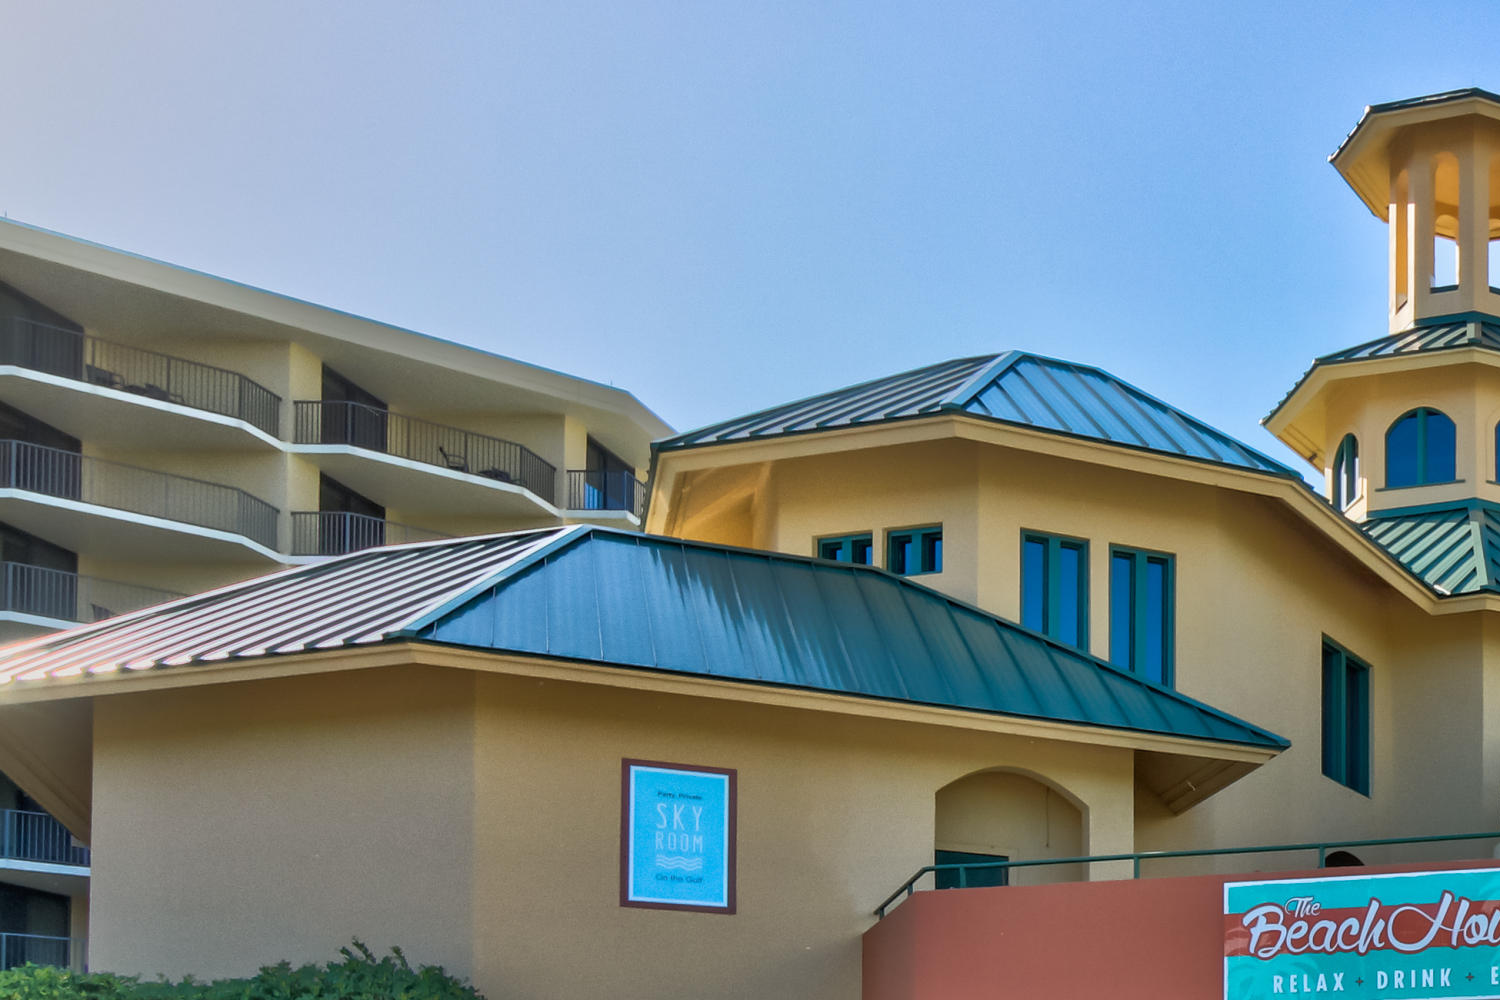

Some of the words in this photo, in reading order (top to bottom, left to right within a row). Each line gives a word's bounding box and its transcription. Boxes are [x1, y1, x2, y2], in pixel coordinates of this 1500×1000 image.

[656, 803, 703, 832] SKY
[655, 831, 703, 853] ROOM
[1284, 896, 1321, 917] The
[1242, 897, 1386, 959] Beach
[1272, 972, 1346, 994] RELAX
[1376, 967, 1453, 990] DRINK
